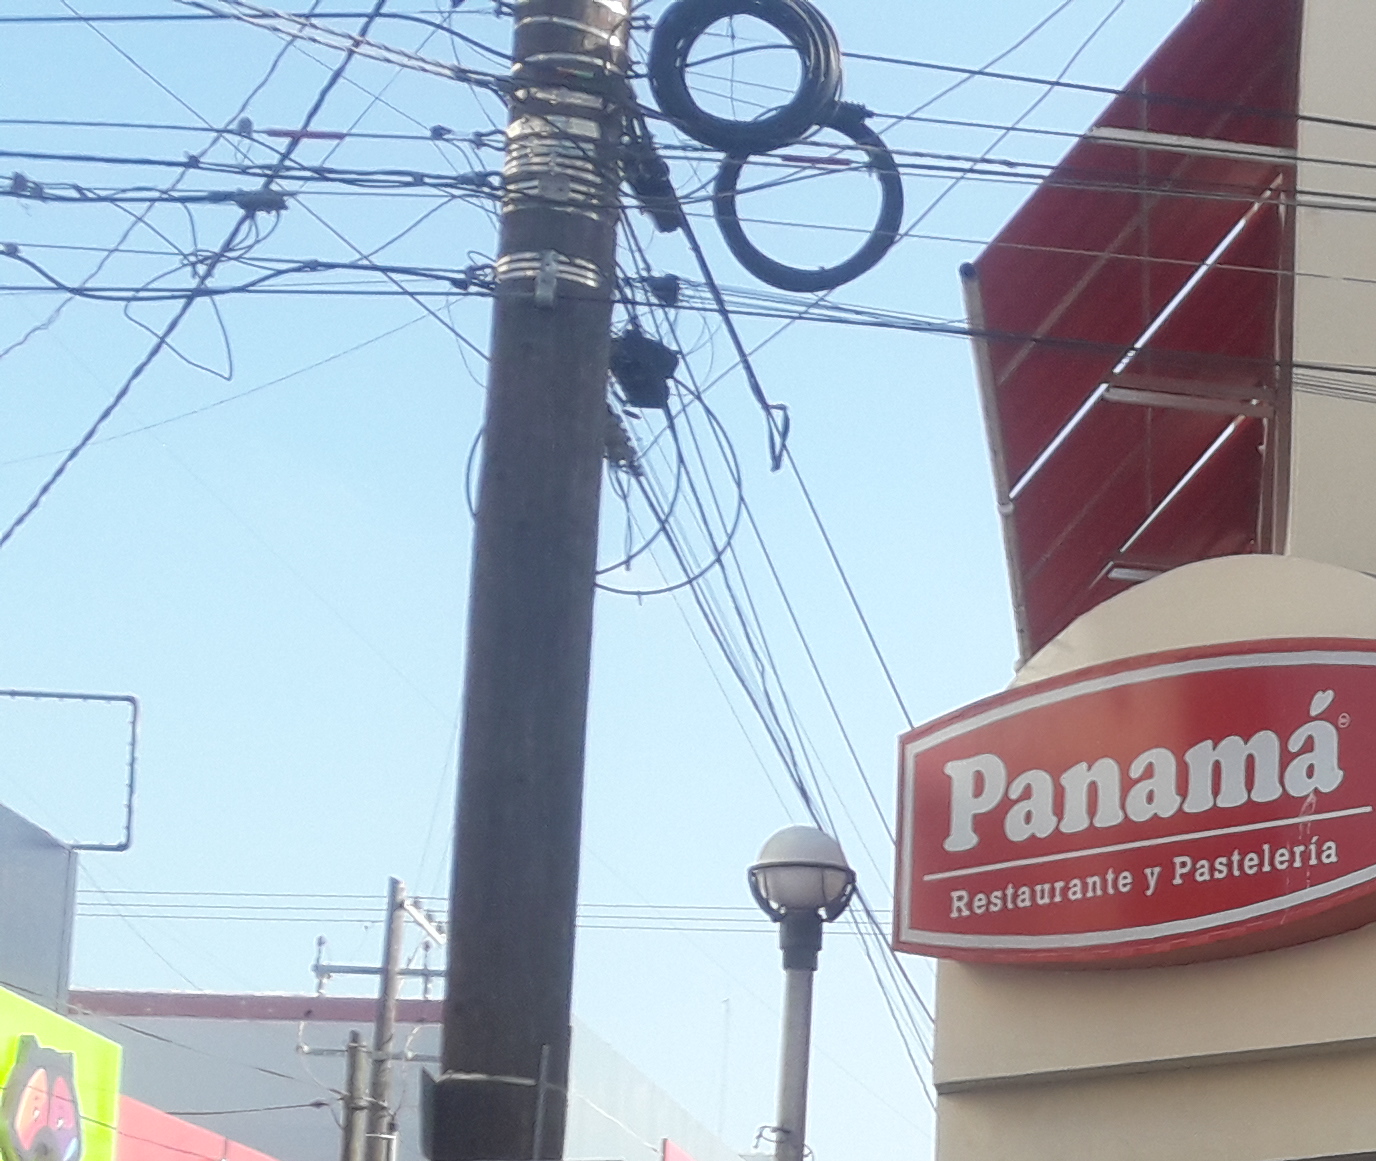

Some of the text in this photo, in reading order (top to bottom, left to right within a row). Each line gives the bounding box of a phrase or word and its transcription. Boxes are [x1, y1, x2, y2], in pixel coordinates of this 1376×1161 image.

[943, 690, 1345, 852] Panamá
[949, 837, 1340, 919] Restaurante y Pastelería
